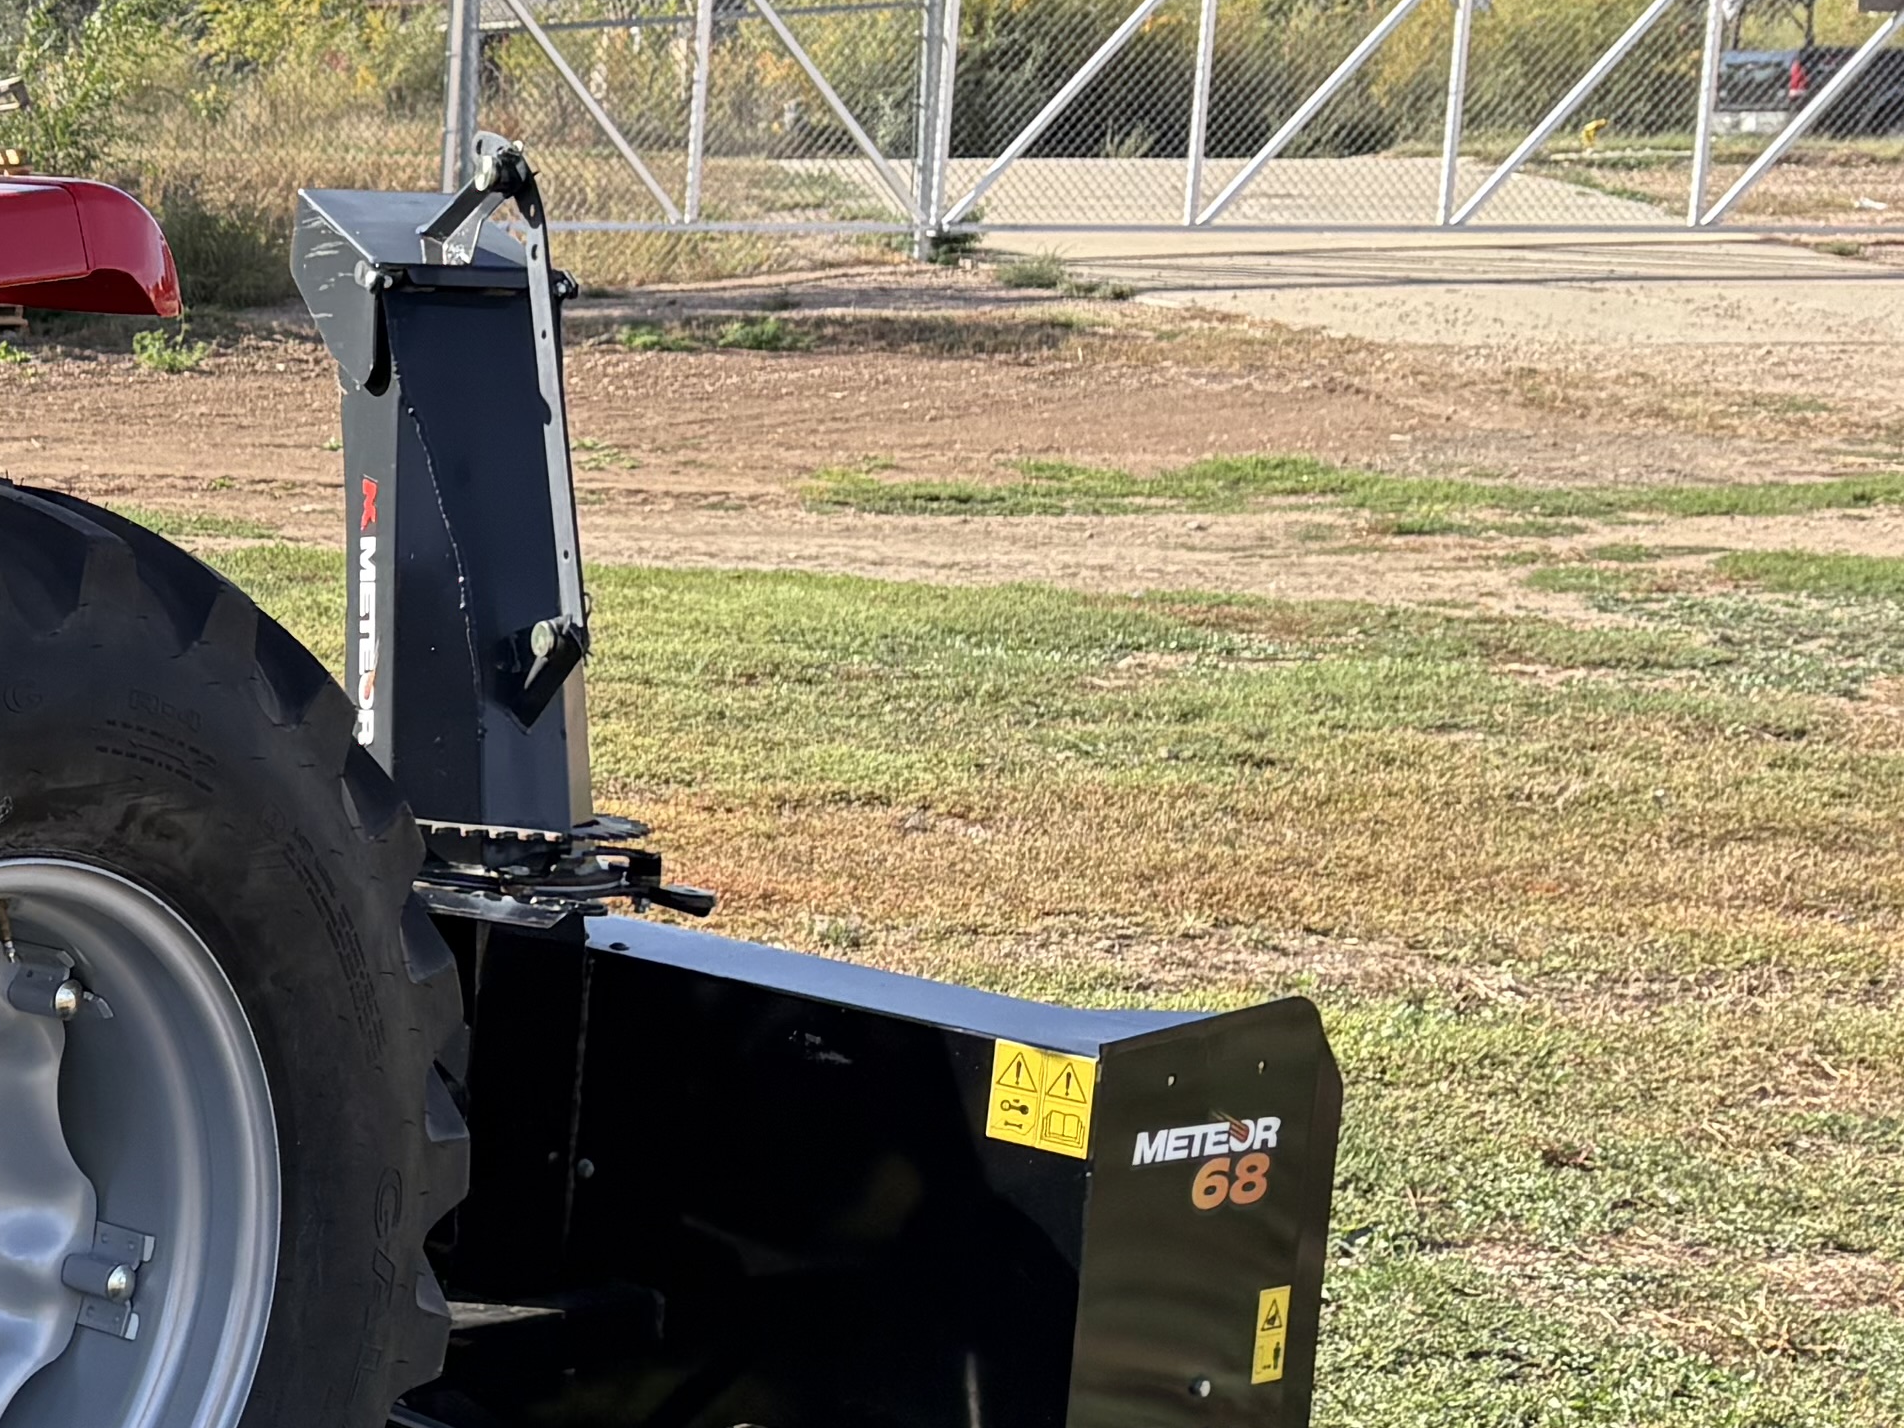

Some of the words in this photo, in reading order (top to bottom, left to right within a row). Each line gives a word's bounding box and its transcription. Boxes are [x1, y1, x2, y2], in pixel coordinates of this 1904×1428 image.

[357, 536, 377, 746] METEOR
[1132, 1116, 1282, 1166] METEOR
[1192, 1152, 1270, 1210] 68
